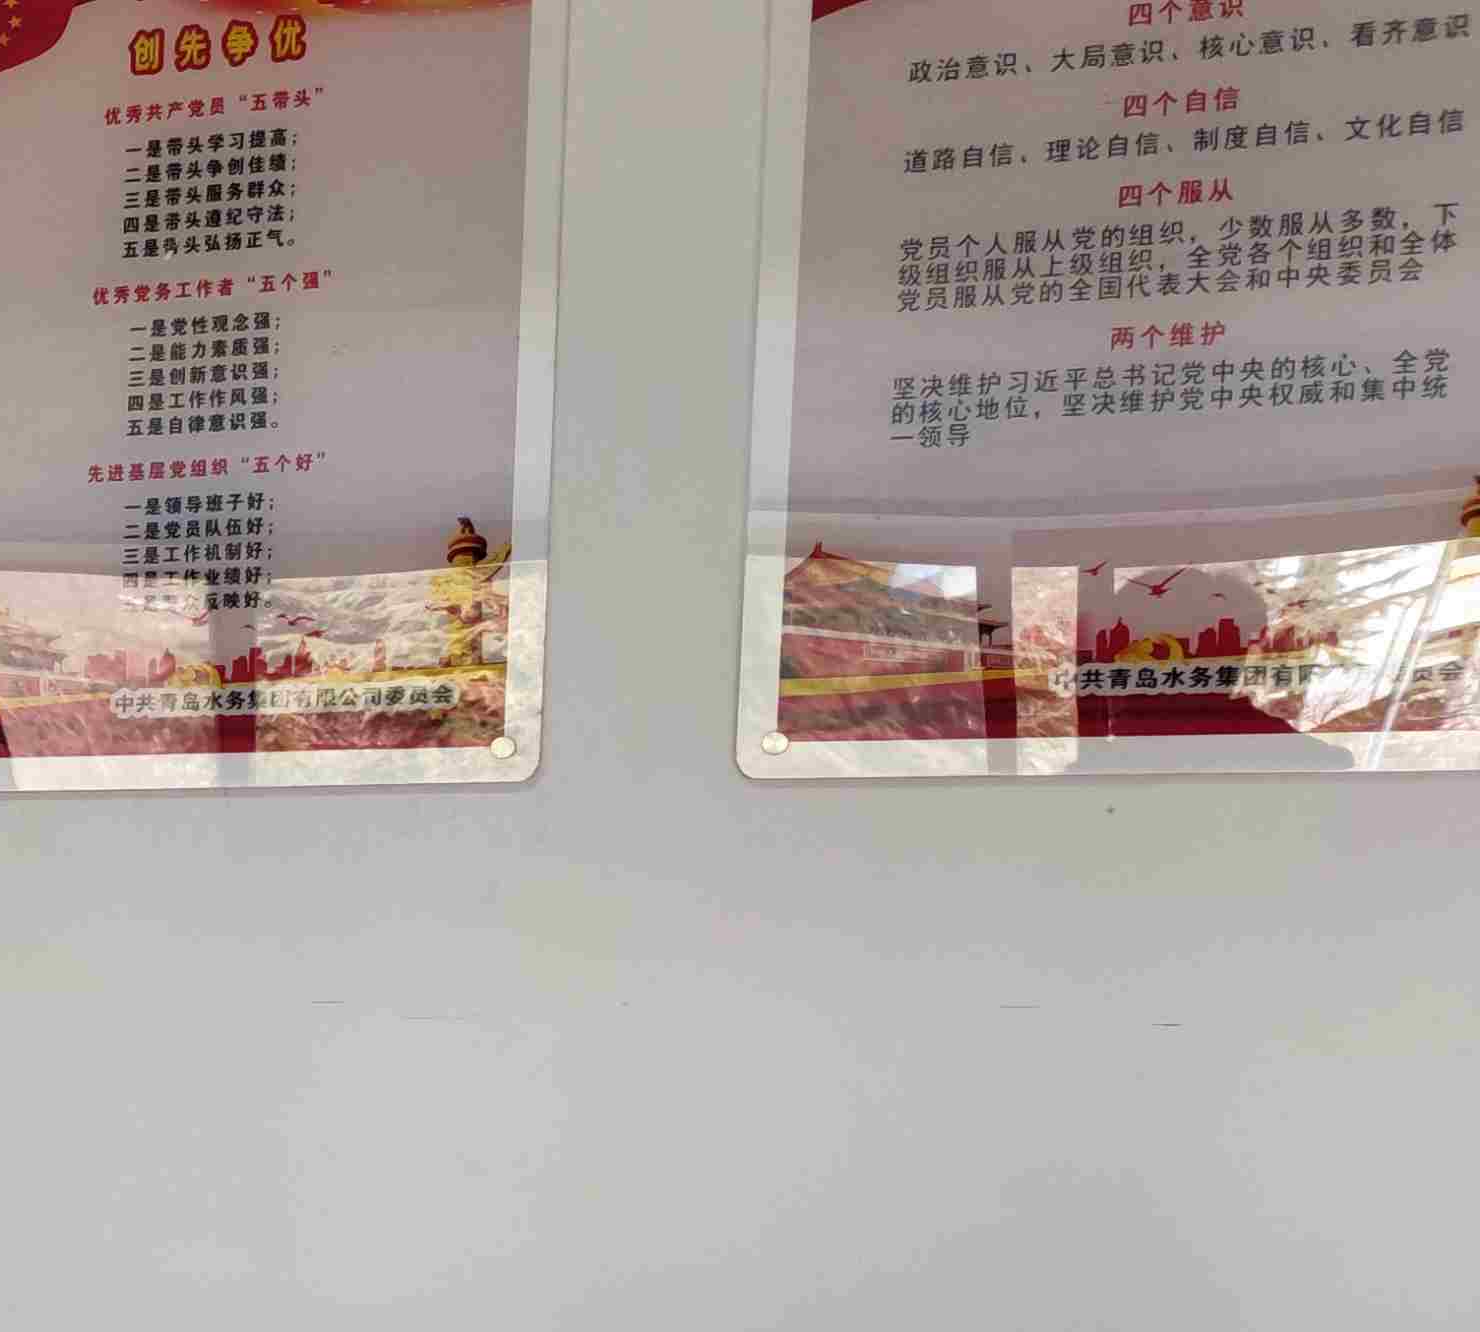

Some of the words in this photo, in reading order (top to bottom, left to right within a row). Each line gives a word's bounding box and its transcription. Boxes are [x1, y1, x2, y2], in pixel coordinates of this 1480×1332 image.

[1127, 0, 1246, 26] 四个意识
[129, 14, 306, 75] 创先争优
[1122, 87, 1241, 118] 四个自信
[1117, 177, 1235, 208] 四个服从
[1110, 322, 1227, 351] 两个维护
[889, 424, 970, 449] 一领导
